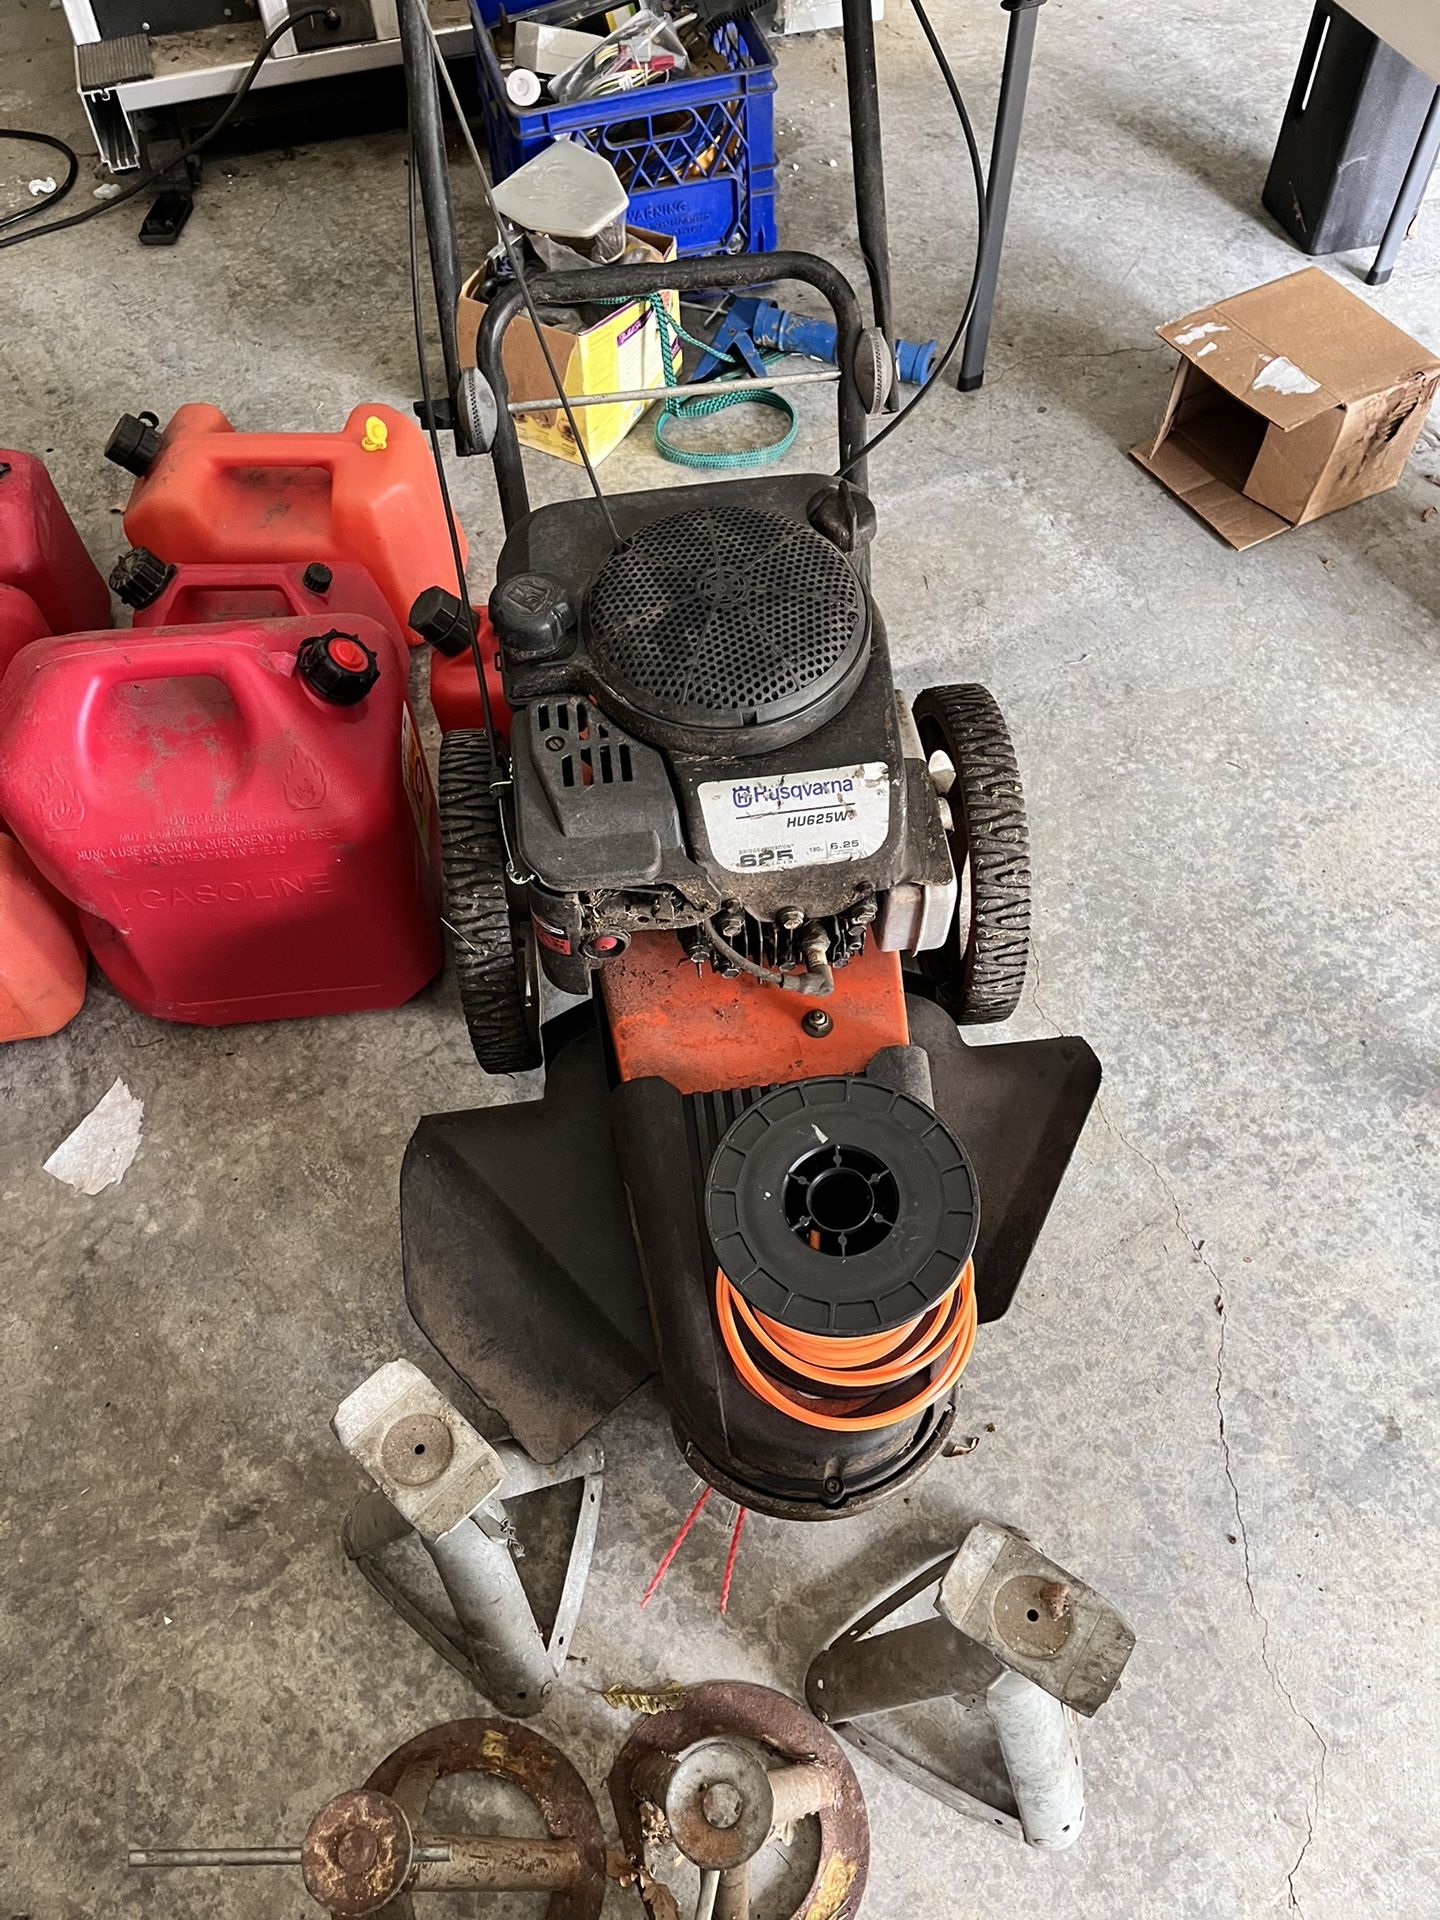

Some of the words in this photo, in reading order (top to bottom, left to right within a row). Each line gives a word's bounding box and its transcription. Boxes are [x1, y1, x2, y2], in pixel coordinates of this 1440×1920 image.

[754, 778, 853, 803] Husqvarna
[204, 833, 274, 850] QUEROSENO
[830, 839, 859, 850] 6.25
[740, 849, 793, 867] 625
[136, 873, 334, 909] GASOLINE
